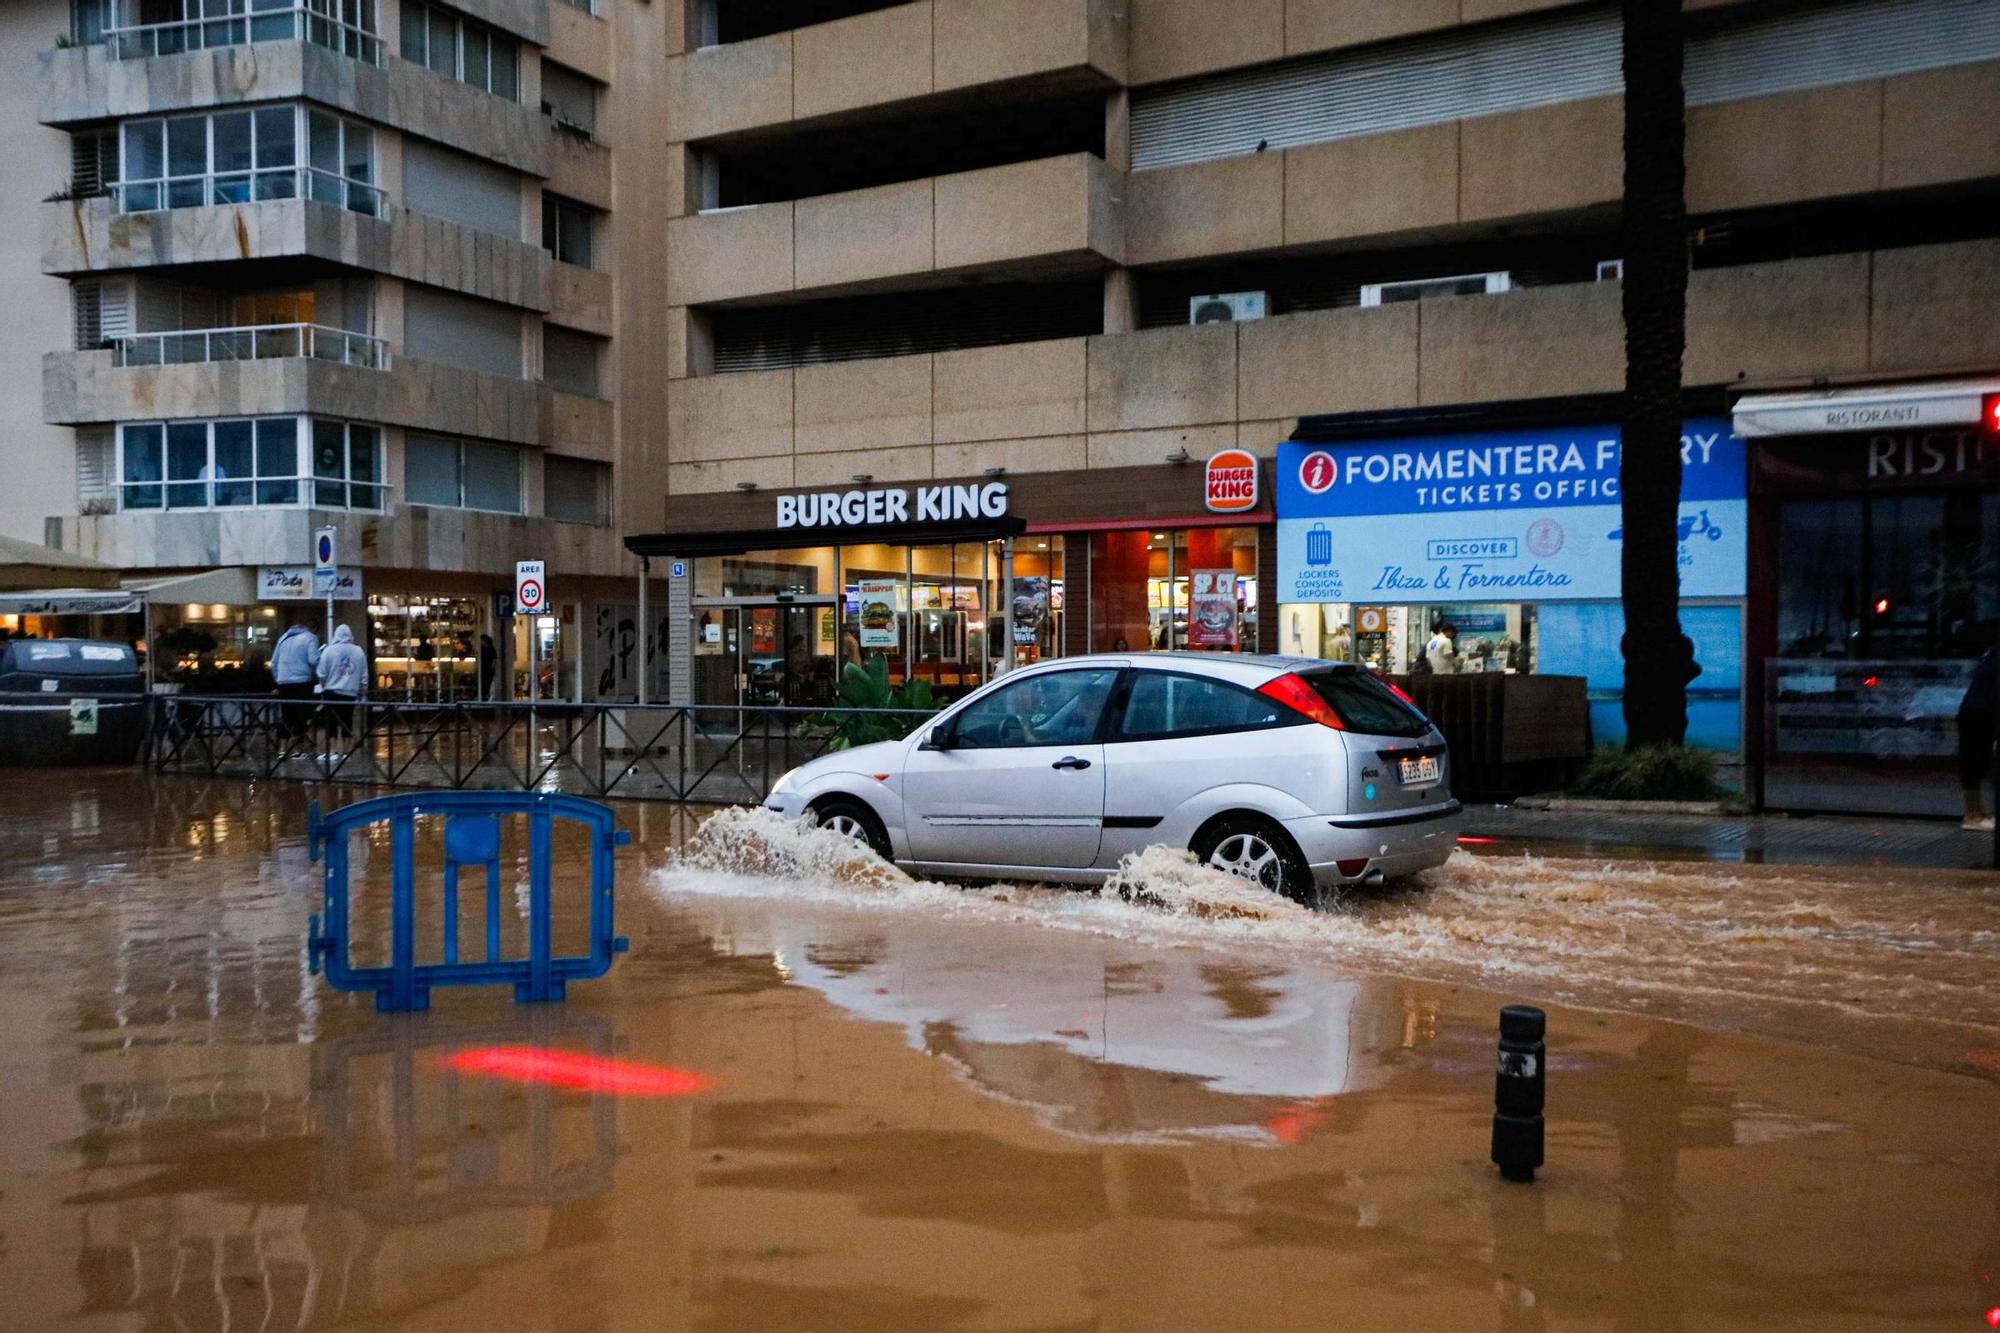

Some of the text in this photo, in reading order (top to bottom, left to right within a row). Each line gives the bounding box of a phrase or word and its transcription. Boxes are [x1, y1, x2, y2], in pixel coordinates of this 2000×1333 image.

[1825, 406, 1920, 426] RISTORANTI
[1345, 432, 1719, 485] FORMENTERA FRY
[1867, 430, 1983, 478] RIST
[1208, 468, 1254, 482] BURGER
[1208, 480, 1254, 498] KING
[1416, 477, 1619, 506] TICKETS OFFIC
[776, 481, 1008, 529] BURGER KING
[1436, 541, 1509, 556] DISCOVER
[1295, 579, 1344, 589] CONSIGNA
[1298, 569, 1340, 579] LOCKERS
[1371, 563, 1573, 592] Ibiza & Formentera
[524, 588, 538, 599] 30
[499, 595, 511, 616] P
